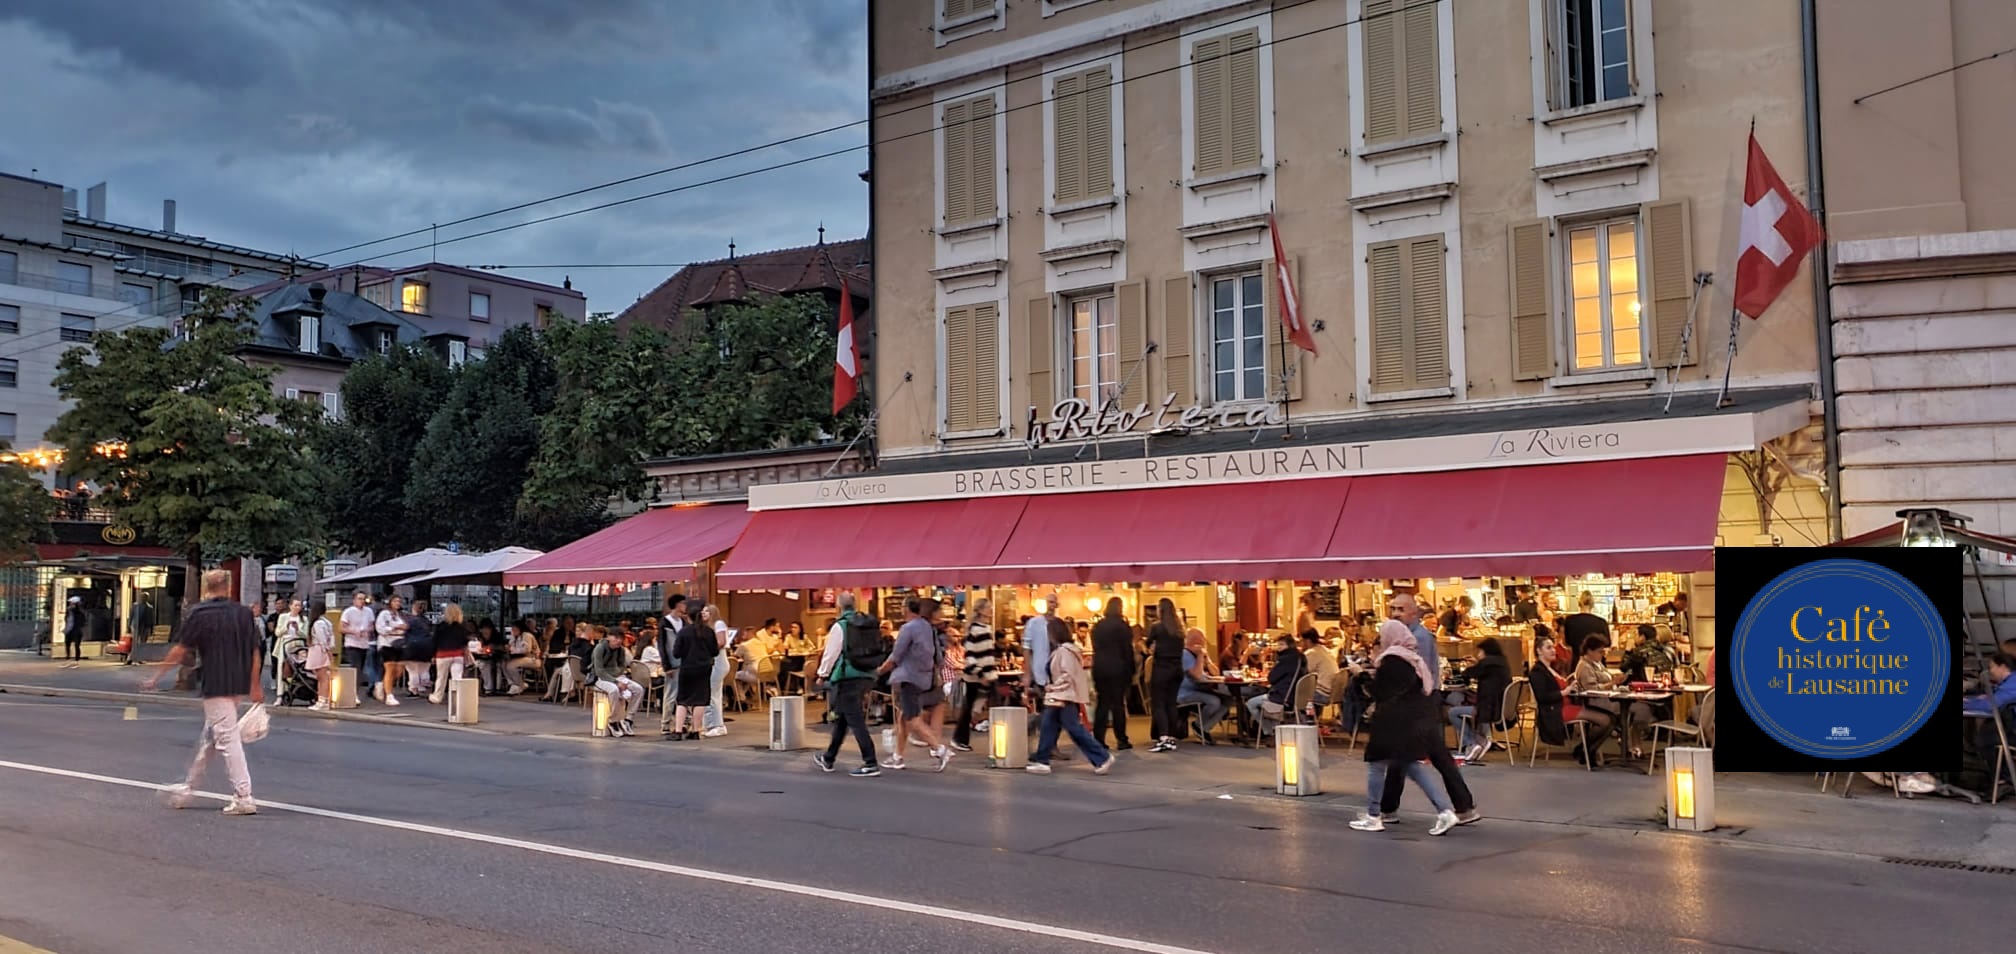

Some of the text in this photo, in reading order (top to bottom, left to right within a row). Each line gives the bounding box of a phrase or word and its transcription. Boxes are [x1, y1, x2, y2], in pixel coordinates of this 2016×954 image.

[1051, 392, 1284, 441] Riviera
[1526, 429, 1620, 457] Riviera
[955, 463, 1105, 494] BRASSERIE
[1144, 444, 1371, 482] RESTAURANT
[835, 479, 887, 501] Riviera
